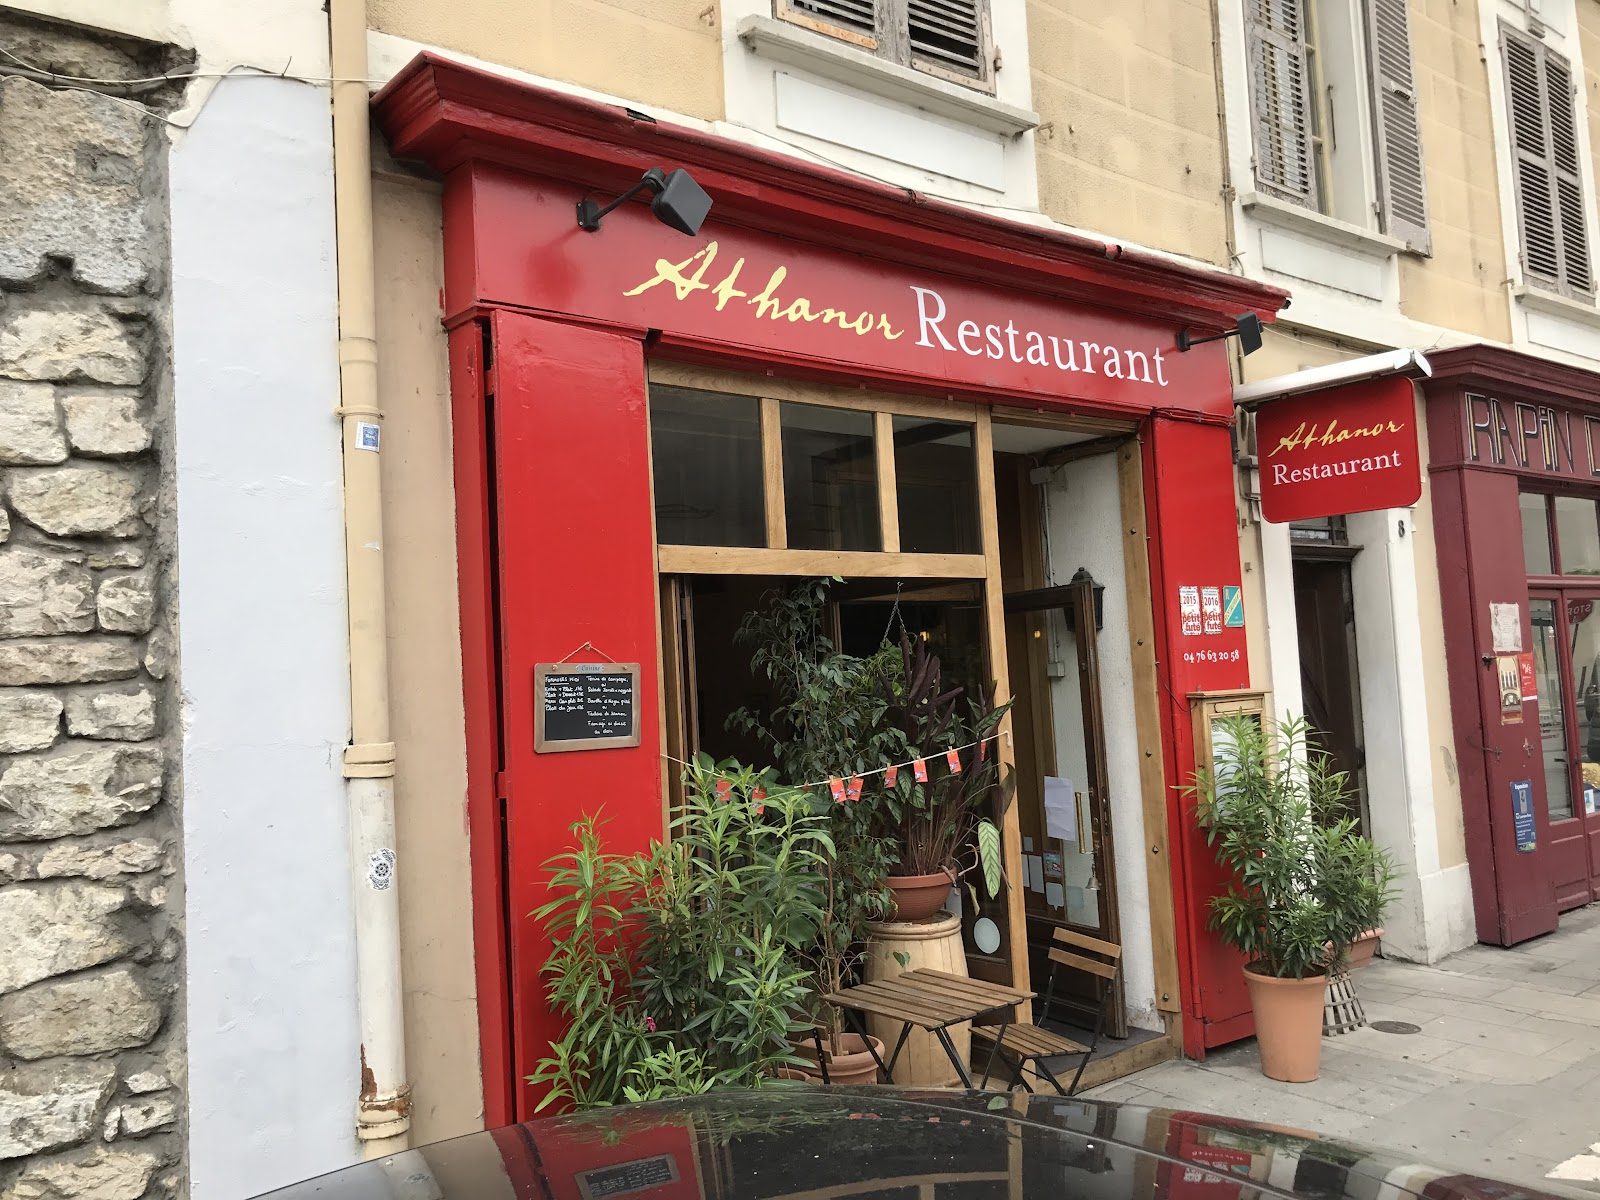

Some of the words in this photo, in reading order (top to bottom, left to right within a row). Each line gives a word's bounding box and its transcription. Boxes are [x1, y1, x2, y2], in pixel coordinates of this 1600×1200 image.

[623, 241, 905, 340] Athanor
[909, 286, 1169, 387] Restaurant
[1267, 420, 1405, 457] Athanor
[1272, 449, 1401, 486] Restaurant
[1398, 519, 1405, 538] 8
[1183, 596, 1196, 605] 2015
[1204, 597, 1218, 606] 2016
[1184, 652, 1194, 663] 04
[1196, 650, 1206, 663] 76
[1207, 650, 1217, 662] 63
[1219, 652, 1228, 660] 20
[1231, 649, 1239, 662] 58
